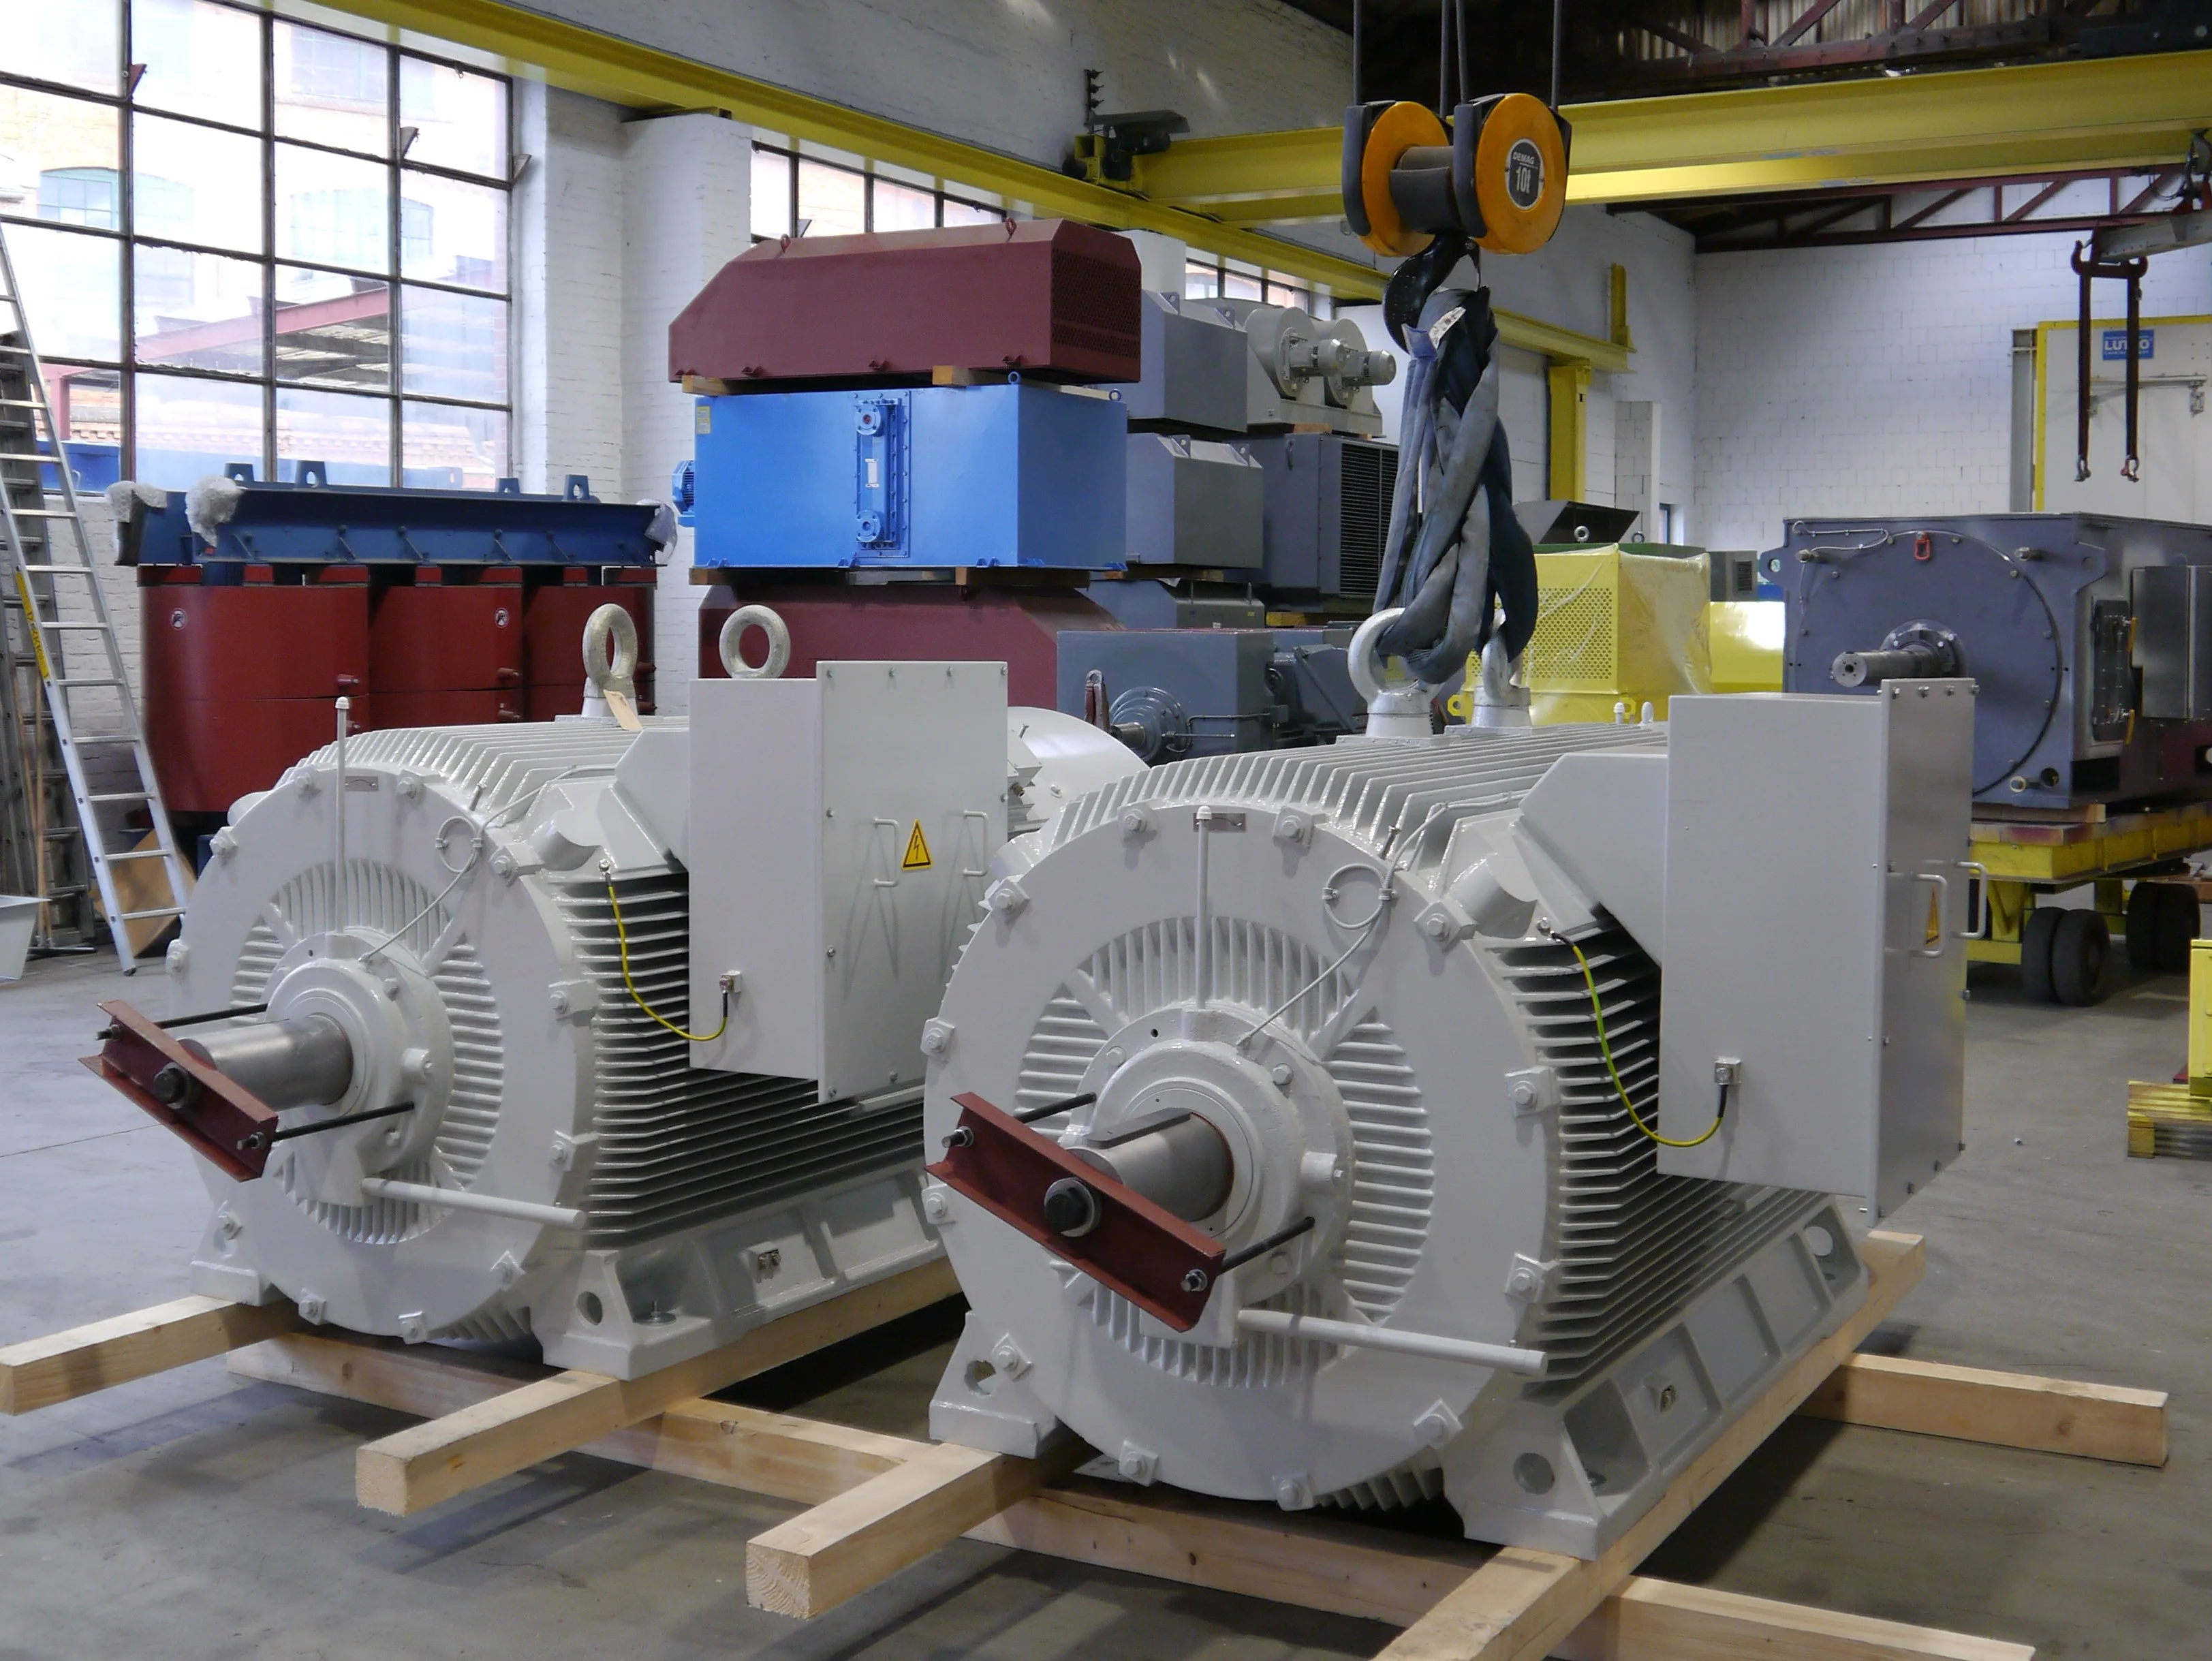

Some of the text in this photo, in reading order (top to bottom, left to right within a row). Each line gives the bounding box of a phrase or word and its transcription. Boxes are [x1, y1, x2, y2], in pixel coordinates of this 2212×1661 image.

[1513, 151, 1535, 165] DEMAG
[1516, 166, 1531, 193] 10t
[2104, 339, 2150, 350] LUTO
